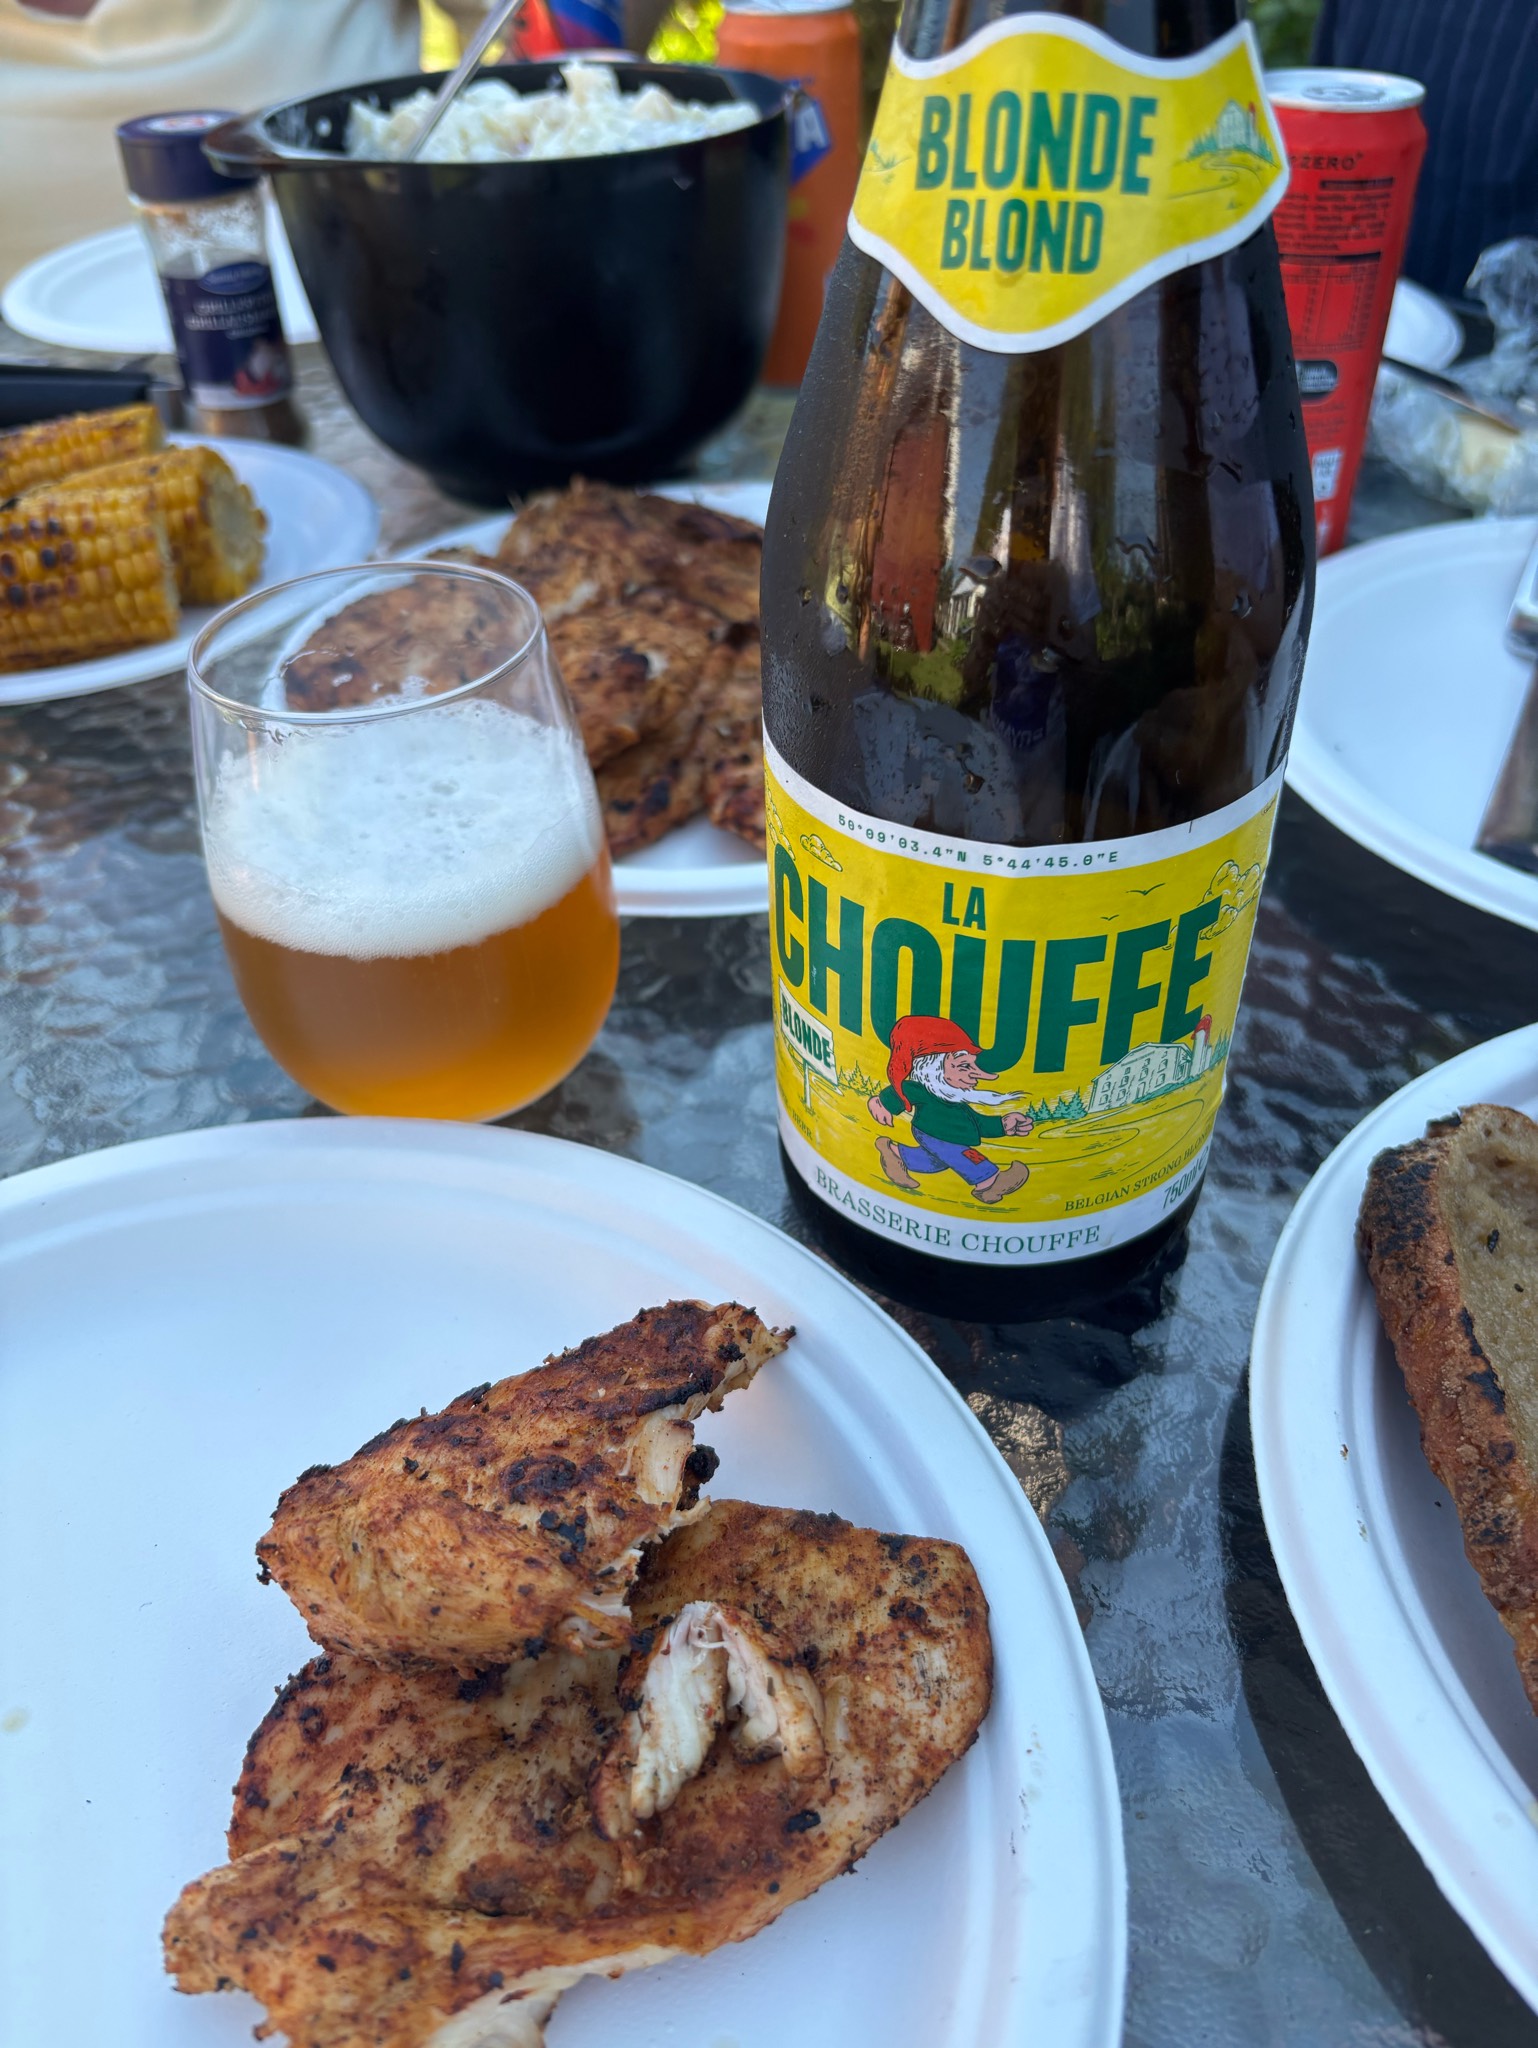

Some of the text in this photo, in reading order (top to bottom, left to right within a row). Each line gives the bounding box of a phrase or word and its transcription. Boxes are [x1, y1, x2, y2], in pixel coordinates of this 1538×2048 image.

[915, 90, 1158, 195] BLONDE
[940, 198, 1105, 274] BLOND
[943, 882, 987, 931] LA
[774, 842, 1222, 1074] CHOUFFE
[781, 992, 833, 1069] BLONDE
[816, 1166, 1100, 1254] BRASSERIE CHOUFFE
[1065, 1185, 1130, 1212] BELGIAN
[1133, 1154, 1182, 1192] STRONG
